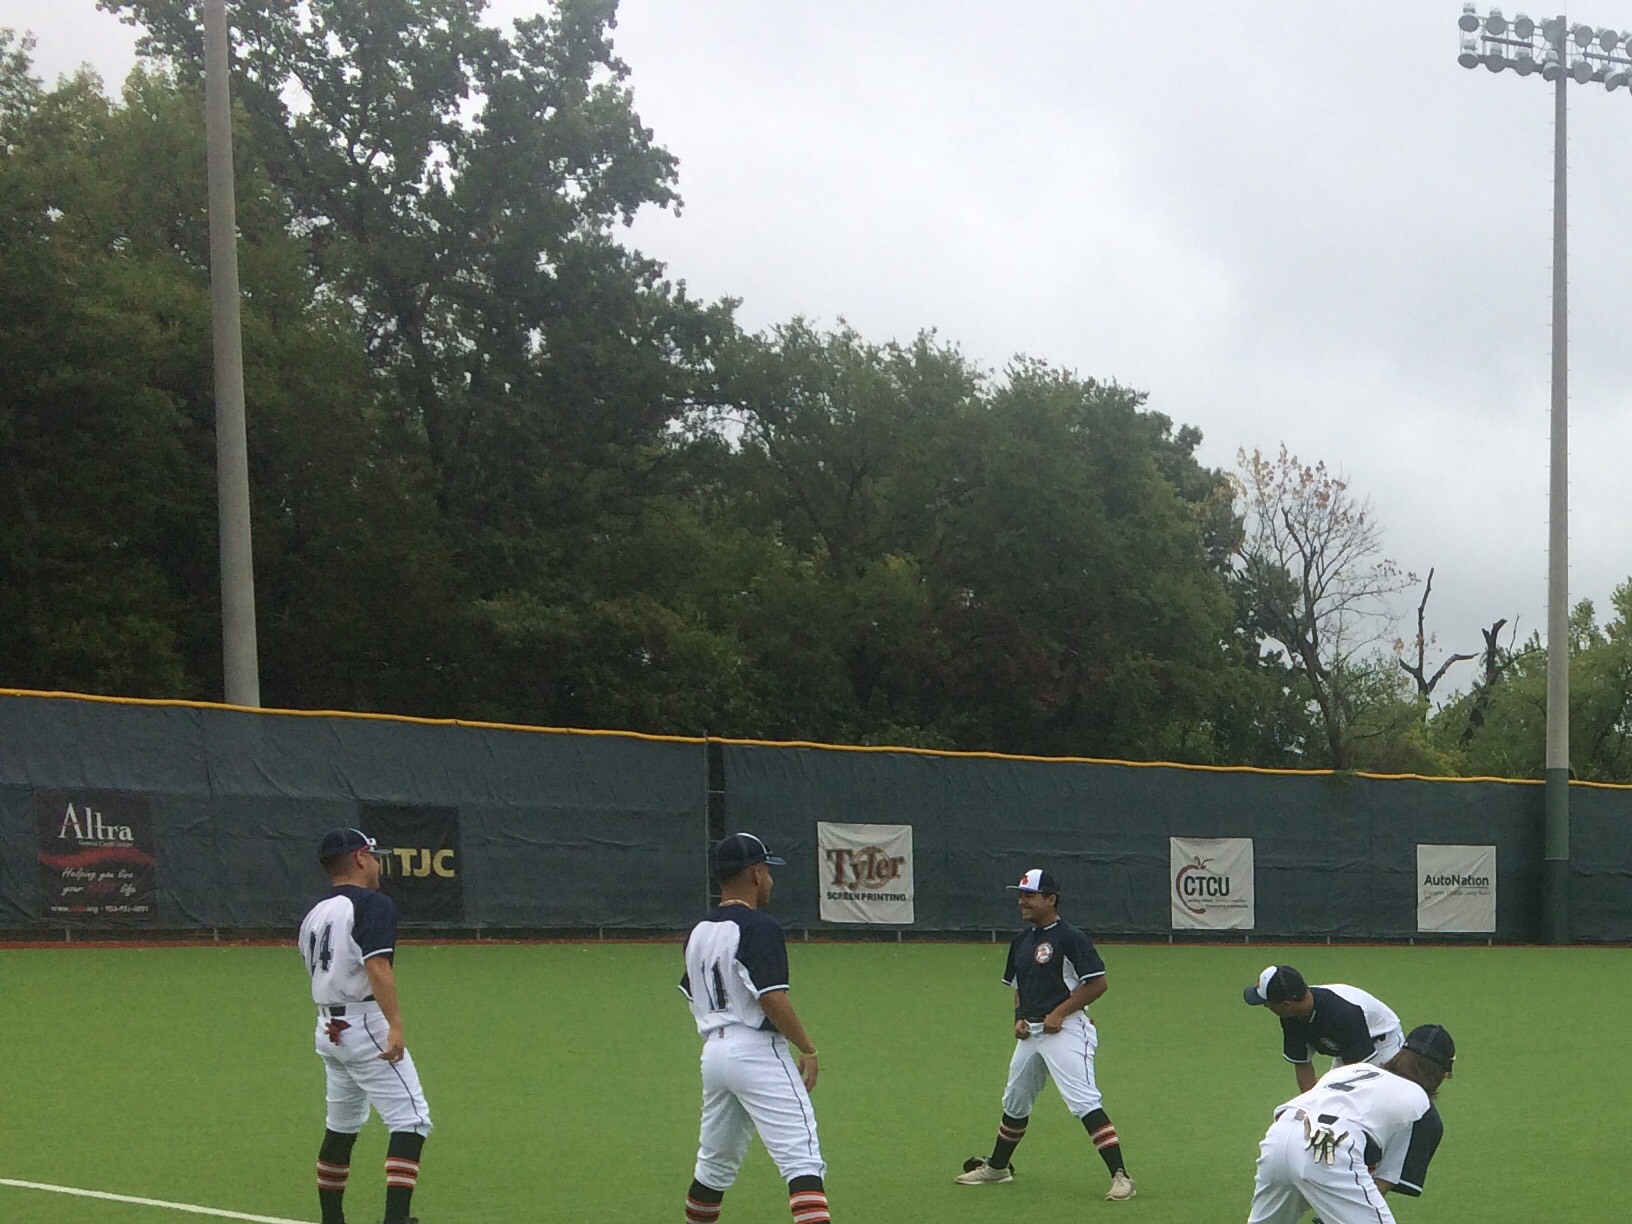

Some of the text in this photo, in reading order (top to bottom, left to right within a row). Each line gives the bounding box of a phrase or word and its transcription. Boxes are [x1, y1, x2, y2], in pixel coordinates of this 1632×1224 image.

[58, 802, 134, 841] Altra
[393, 848, 455, 878] TJC
[826, 848, 906, 891] Tyler
[1183, 875, 1230, 897] CTCU
[1424, 874, 1489, 886] AutoNation
[826, 891, 907, 902] SCREEN PRINTING
[1324, 1068, 1383, 1093] 2
